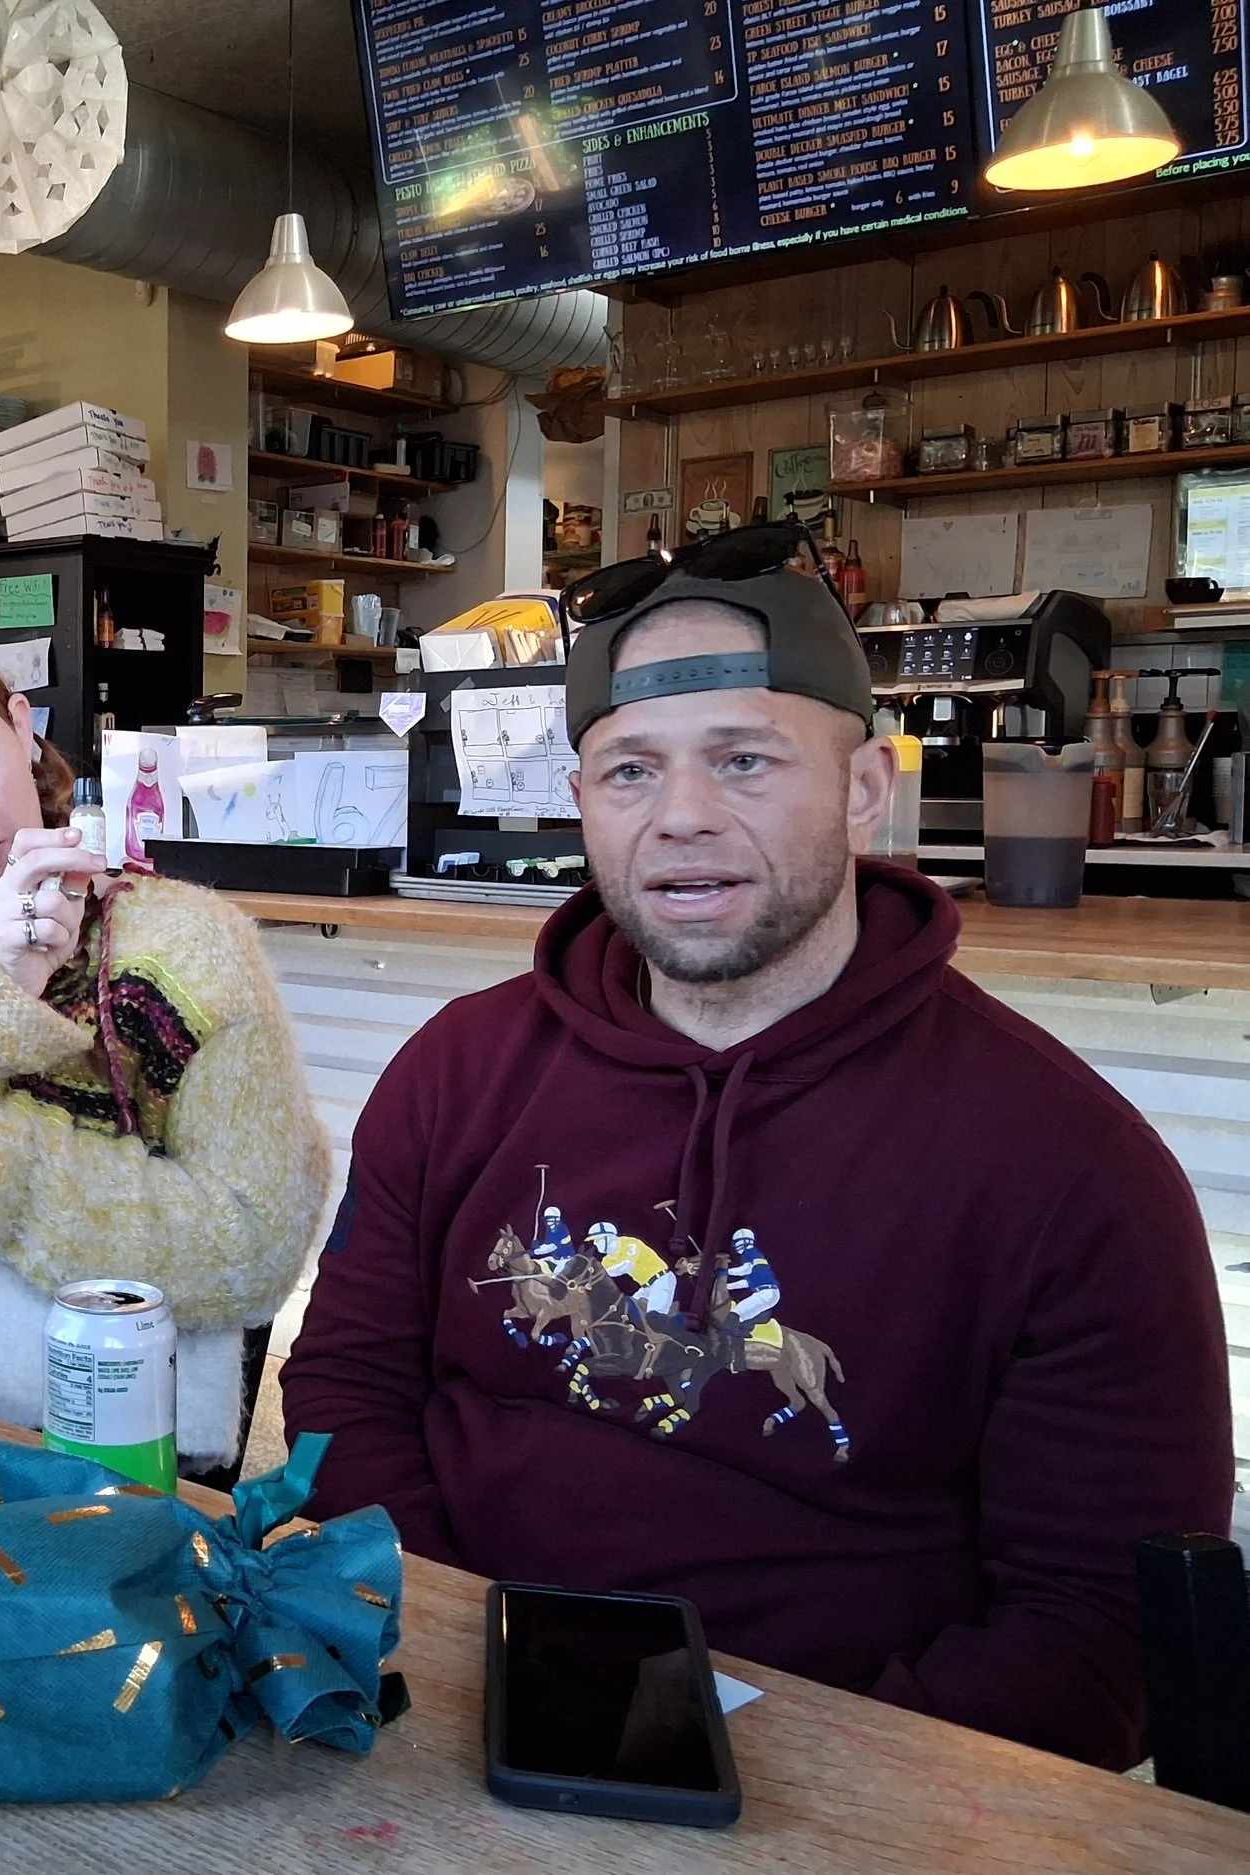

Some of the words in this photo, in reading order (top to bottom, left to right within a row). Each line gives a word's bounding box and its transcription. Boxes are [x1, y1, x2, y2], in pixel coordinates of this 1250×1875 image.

[542, 8, 573, 24] CREAMY
[703, 0, 717, 17] 20
[744, 24, 772, 41] GREEN
[775, 14, 808, 34] STREET
[810, 8, 842, 27] VEGGIE
[845, 0, 880, 17] BURGER
[991, 8, 1033, 30] TURKEY
[518, 27, 527, 42] 15
[545, 38, 580, 57] COCONUT
[582, 30, 608, 46] CURRY
[709, 35, 722, 51] 23
[760, 42, 800, 61] SEAFOOD
[801, 34, 822, 50] FISH
[824, 23, 872, 44] SANDWICH
[933, 5, 947, 22] 15
[518, 53, 530, 68] 25
[605, 56, 639, 75] PLATTER
[713, 69, 726, 86] 14
[780, 72, 812, 90] ISLAND
[813, 62, 851, 82] SALMON
[853, 53, 889, 72] BURGER
[936, 39, 948, 57] 17
[998, 82, 1039, 104] TURKEY
[1132, 51, 1176, 74] CHEESE
[1156, 65, 1190, 85] BAGEL
[523, 85, 535, 100] 20
[617, 85, 664, 106] QUESADILLA
[751, 110, 796, 130] ULTIMATE
[798, 101, 831, 121] DINNER
[834, 95, 858, 114] MELT
[860, 83, 911, 105] SANDWICH
[937, 75, 951, 93] 15
[582, 134, 611, 155] SIDES
[614, 133, 622, 147] &
[626, 111, 711, 144] ENHANCEMENTS
[755, 144, 788, 163] DOUBLE
[789, 136, 824, 156] DECKER
[825, 127, 869, 148] SMASHED
[871, 119, 907, 138] BURGER
[942, 110, 955, 127] 15
[394, 183, 423, 202] PESTO
[509, 156, 537, 174] PIZZA
[583, 165, 604, 179] FRIES
[757, 178, 785, 195] PLANT
[787, 172, 814, 189] BASED
[816, 165, 848, 183] SMOKE
[850, 159, 879, 176] HOUSE
[881, 156, 899, 171] BBQ
[902, 148, 937, 167] BURGER
[944, 145, 957, 161] 15
[1155, 163, 1191, 179] Before
[1191, 155, 1231, 174] placing
[584, 177, 606, 190] HOME
[607, 171, 628, 185] FRIES
[585, 188, 608, 202] SMALL
[609, 183, 633, 197] GREEN
[634, 177, 658, 192] SALAD
[533, 198, 544, 212] 17
[587, 197, 620, 214] AVOCADO
[588, 210, 615, 225] GRILLED
[616, 203, 647, 219] CHICKEN
[759, 211, 791, 228] CHEESE
[793, 203, 828, 220] BURGER
[895, 190, 904, 205] 6
[950, 178, 960, 195] 9
[535, 223, 547, 236] 25
[589, 221, 618, 236] SMOKED
[619, 215, 649, 231] SALMON
[539, 245, 549, 258] 16
[590, 233, 617, 248] GRILLED
[591, 245, 619, 260] CORNED
[621, 241, 638, 253] BEEF
[640, 236, 661, 251] HASH
[712, 223, 721, 236] 10
[455, 291, 495, 307] undercooked
[603, 268, 621, 281] eggs
[637, 259, 667, 272] increase
[667, 256, 685, 270] your
[686, 252, 699, 264] risk
[700, 249, 709, 261] of
[709, 247, 728, 259] food
[729, 244, 751, 257] borne
[776, 231, 814, 249] especially
[822, 228, 839, 243] you
[840, 225, 860, 237] have
[861, 220, 890, 233] certain
[890, 212, 923, 227] medical
[923, 206, 969, 222] conditions.
[592, 256, 620, 271] GRILLED
[621, 249, 651, 266] SALMON
[713, 236, 722, 248] 10
[626, 1242, 637, 1257] 3
[86, 1375, 92, 1384] 4
